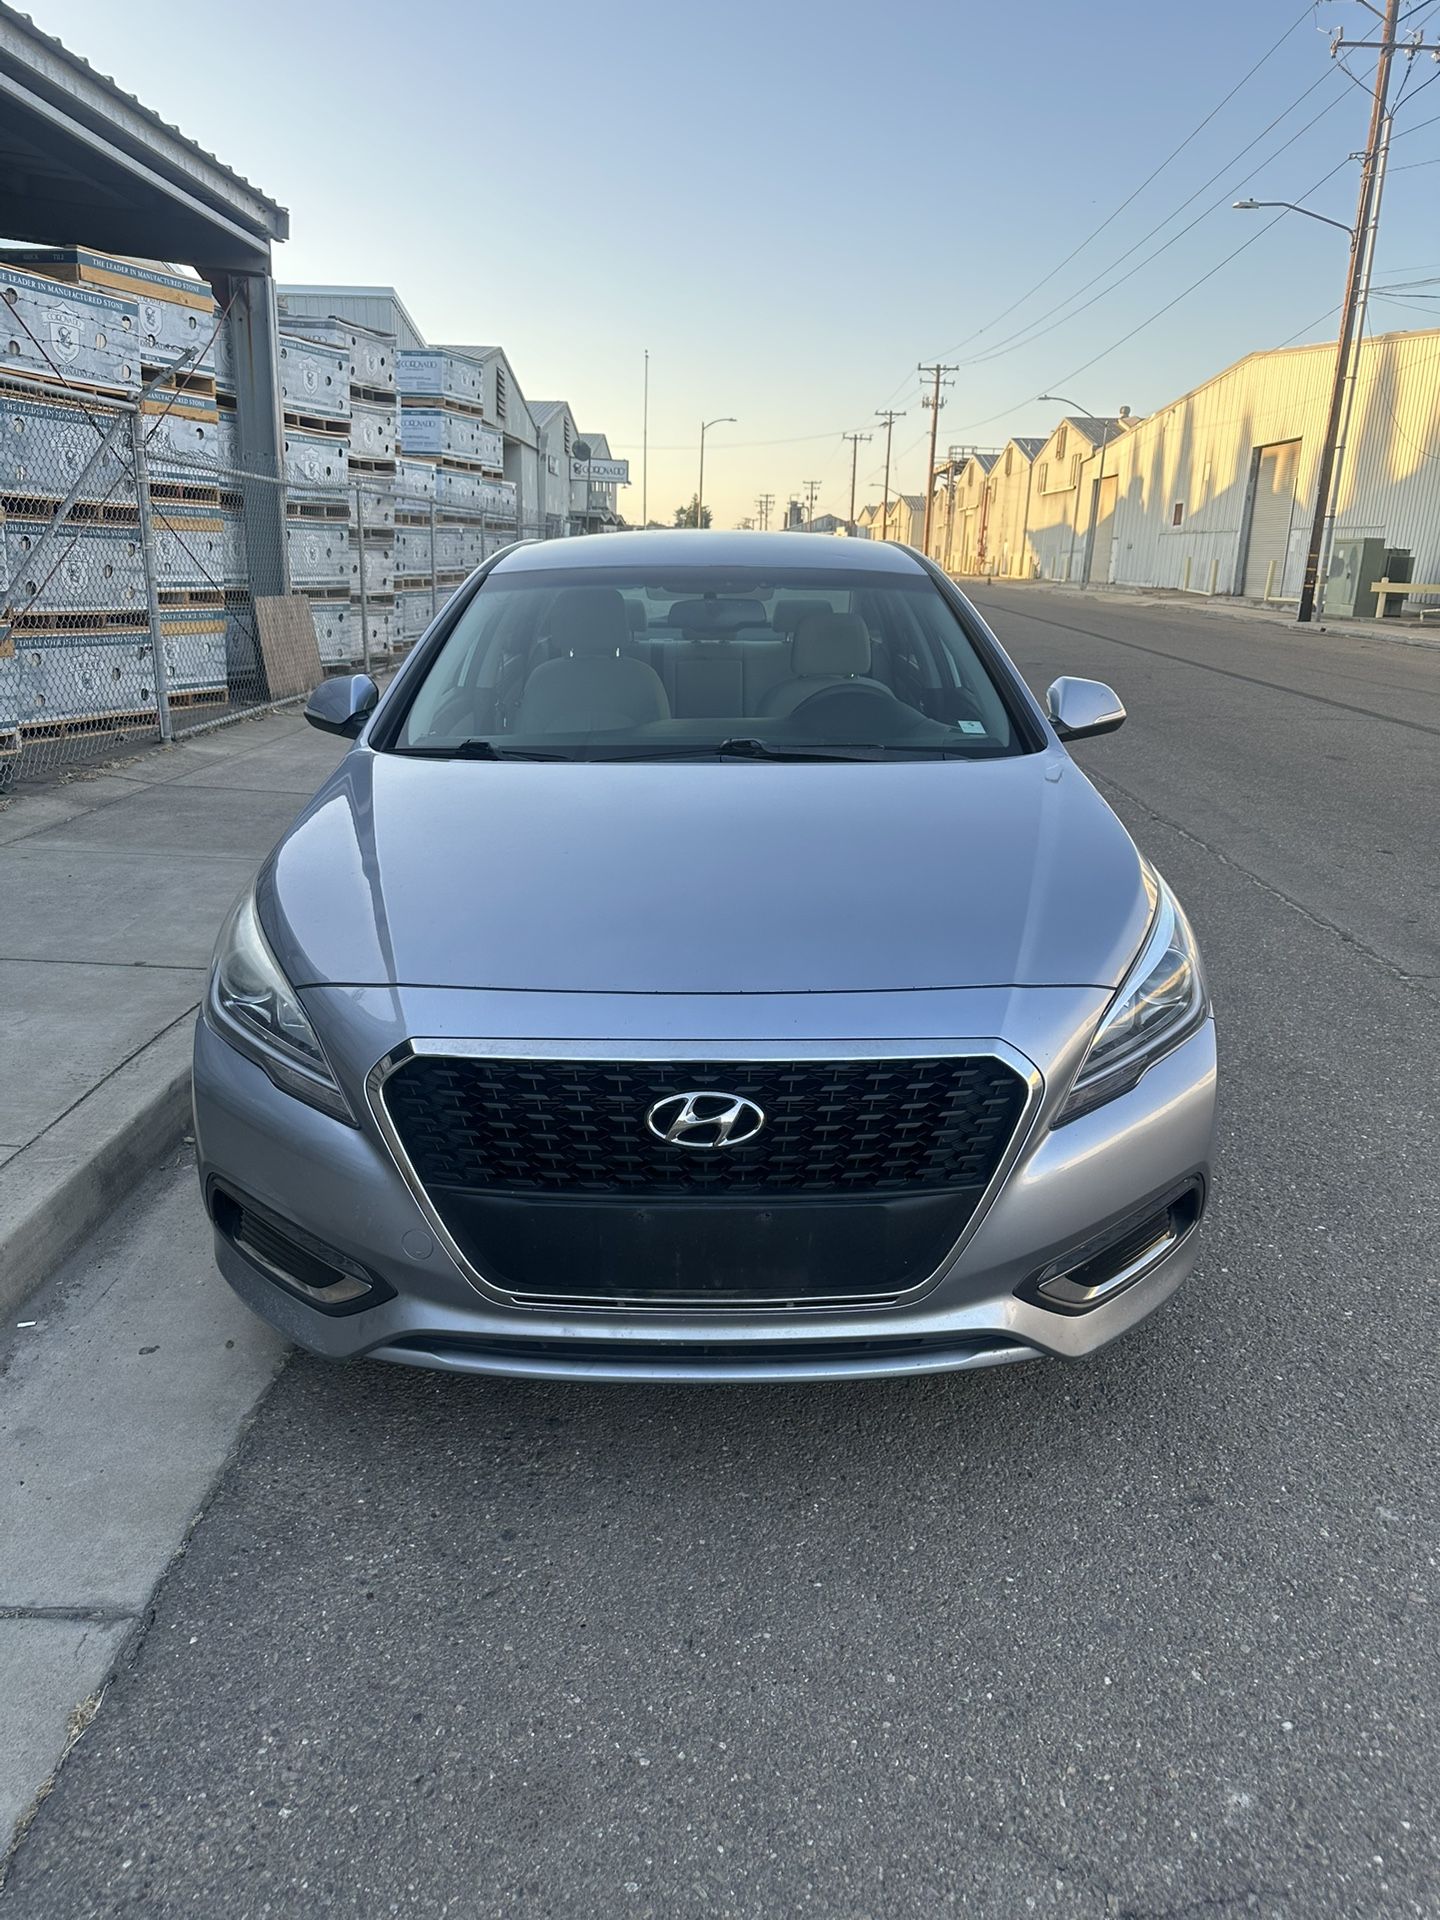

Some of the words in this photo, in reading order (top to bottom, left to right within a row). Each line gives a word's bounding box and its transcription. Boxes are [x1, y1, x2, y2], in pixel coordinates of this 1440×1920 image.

[92, 258, 105, 268] THE
[106, 260, 129, 274] LEADER
[130, 267, 137, 276] IN
[137, 269, 182, 288] MANUFACTURED
[182, 282, 200, 292] STONE
[8, 274, 36, 288] LEADER
[37, 281, 46, 291] IN
[47, 285, 102, 305] MANUFACTURED
[103, 299, 124, 311] STONE
[189, 398, 205, 408] STONE
